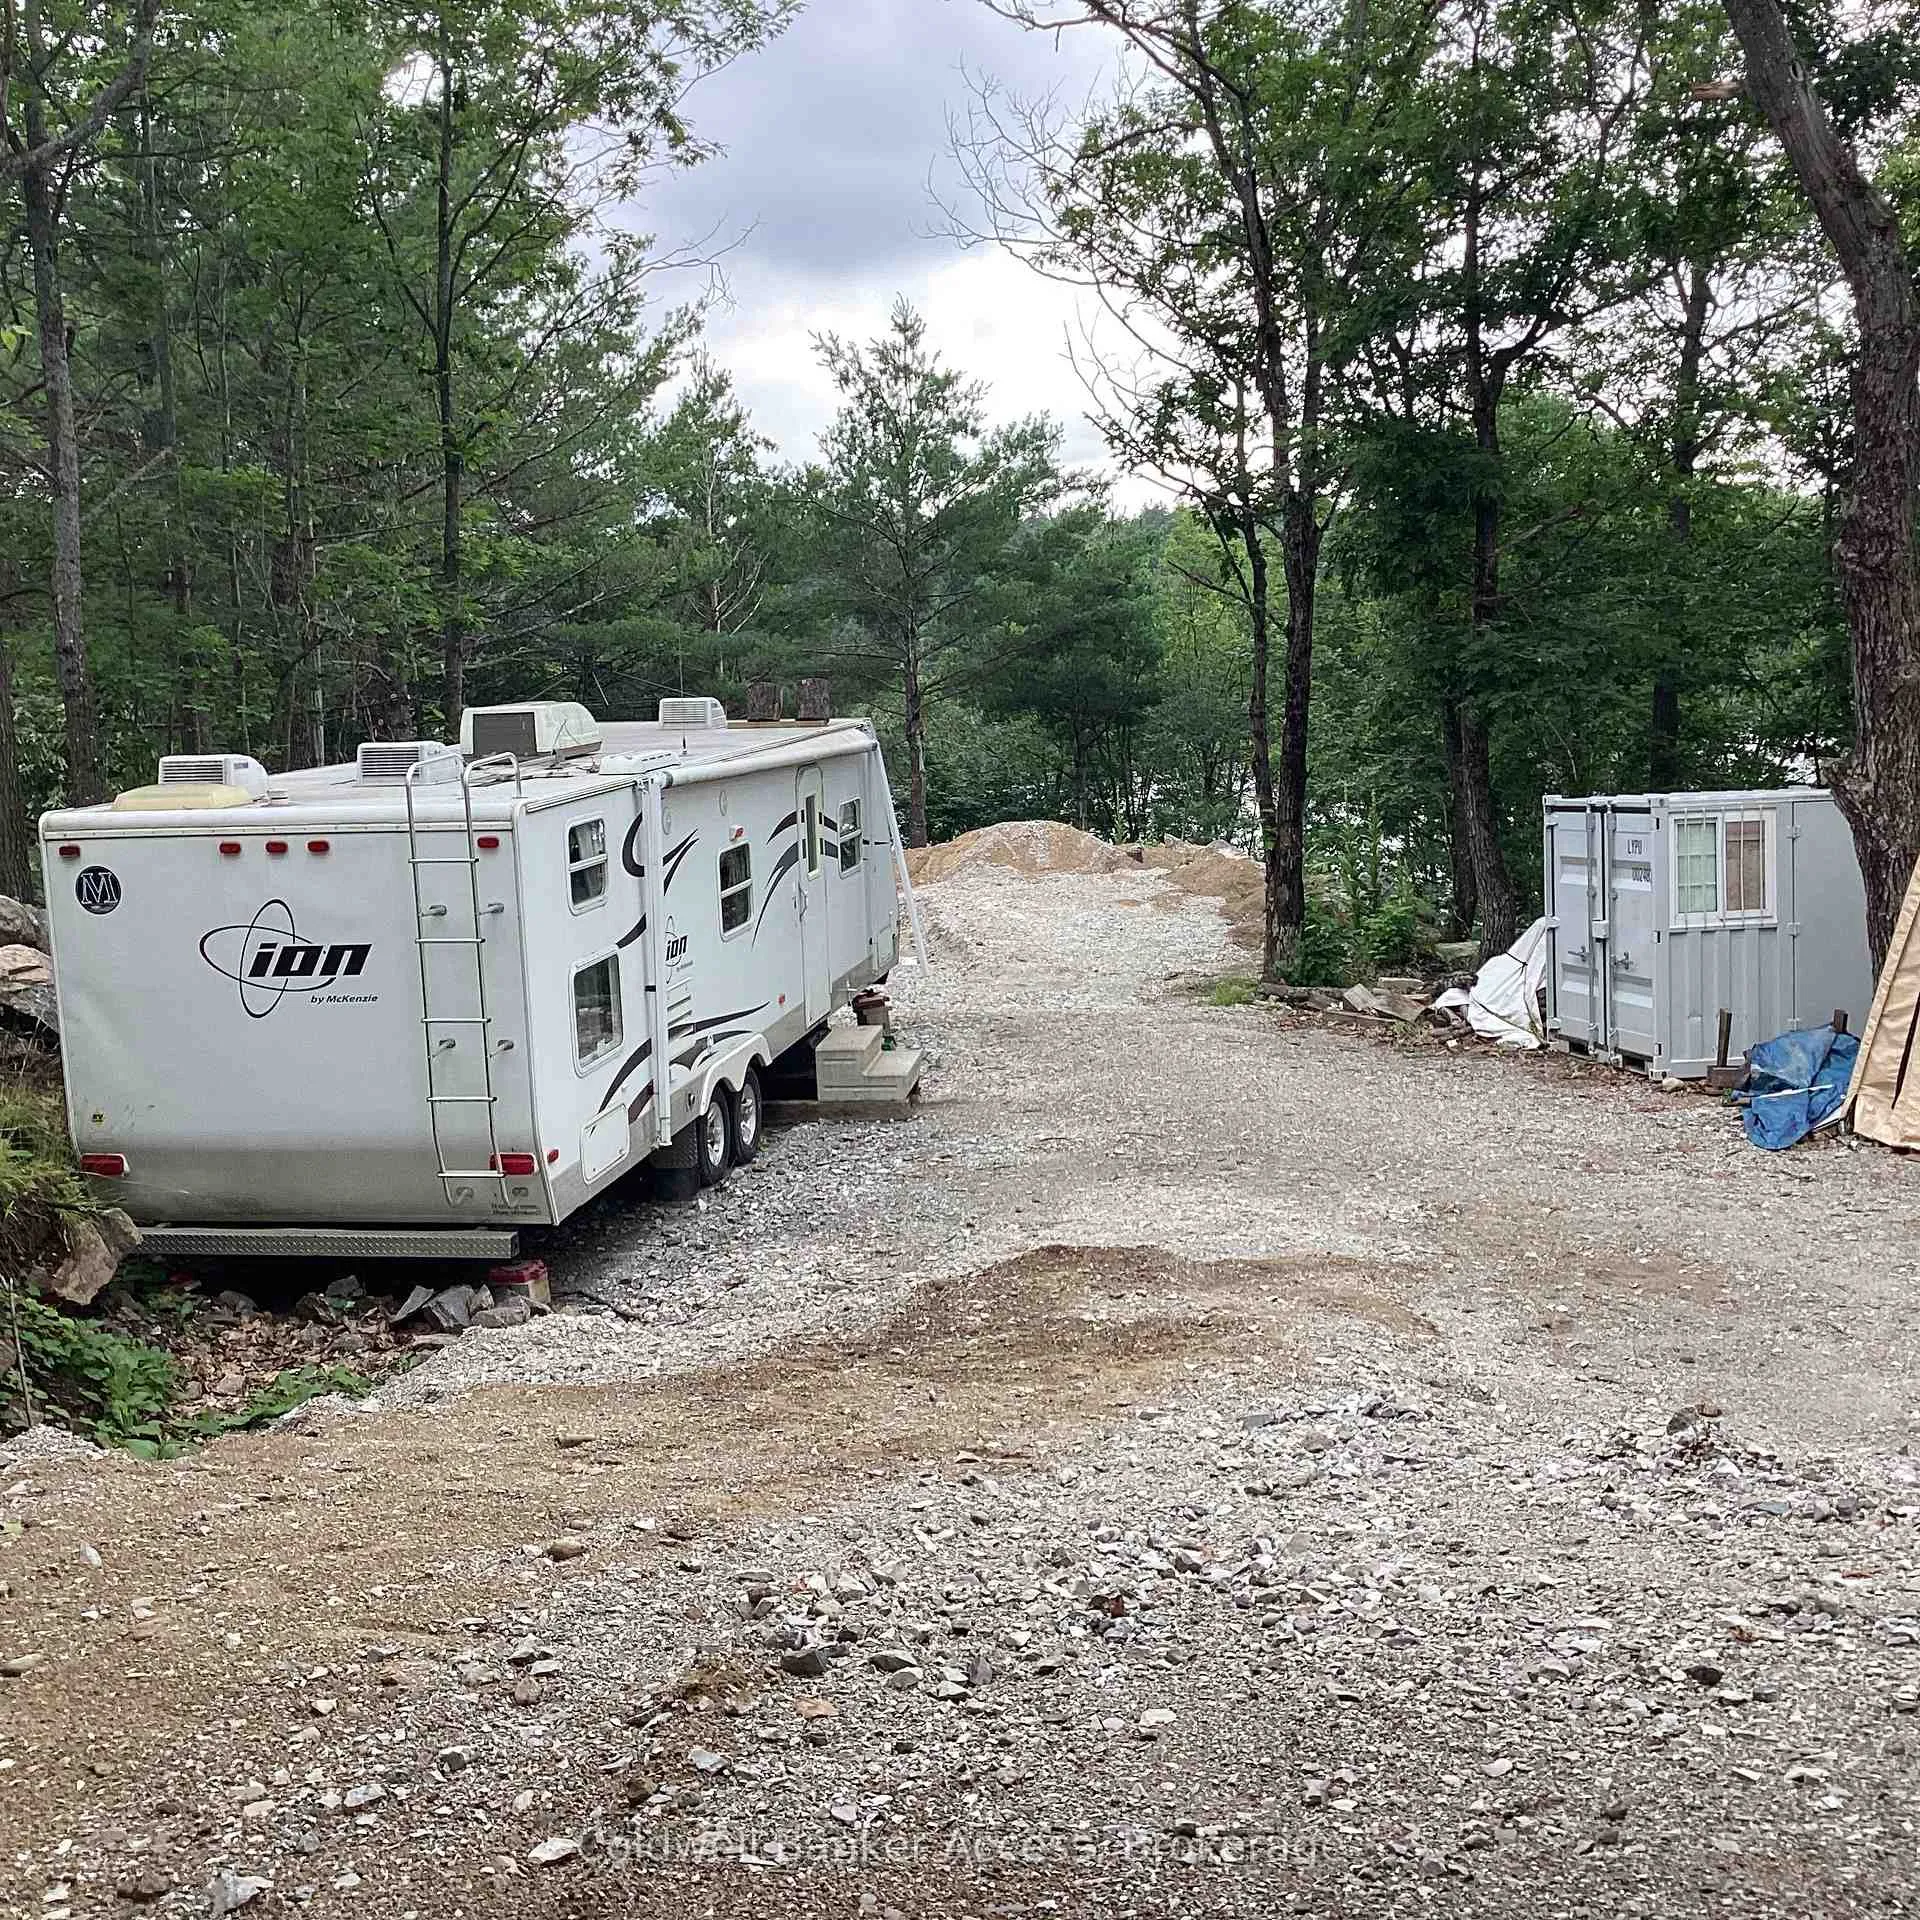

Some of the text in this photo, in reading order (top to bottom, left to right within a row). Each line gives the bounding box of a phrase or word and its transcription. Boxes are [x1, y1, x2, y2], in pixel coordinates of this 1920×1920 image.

[248, 942, 373, 978] ion
[665, 934, 688, 961] ion
[311, 994, 378, 1005] by McKenzie
